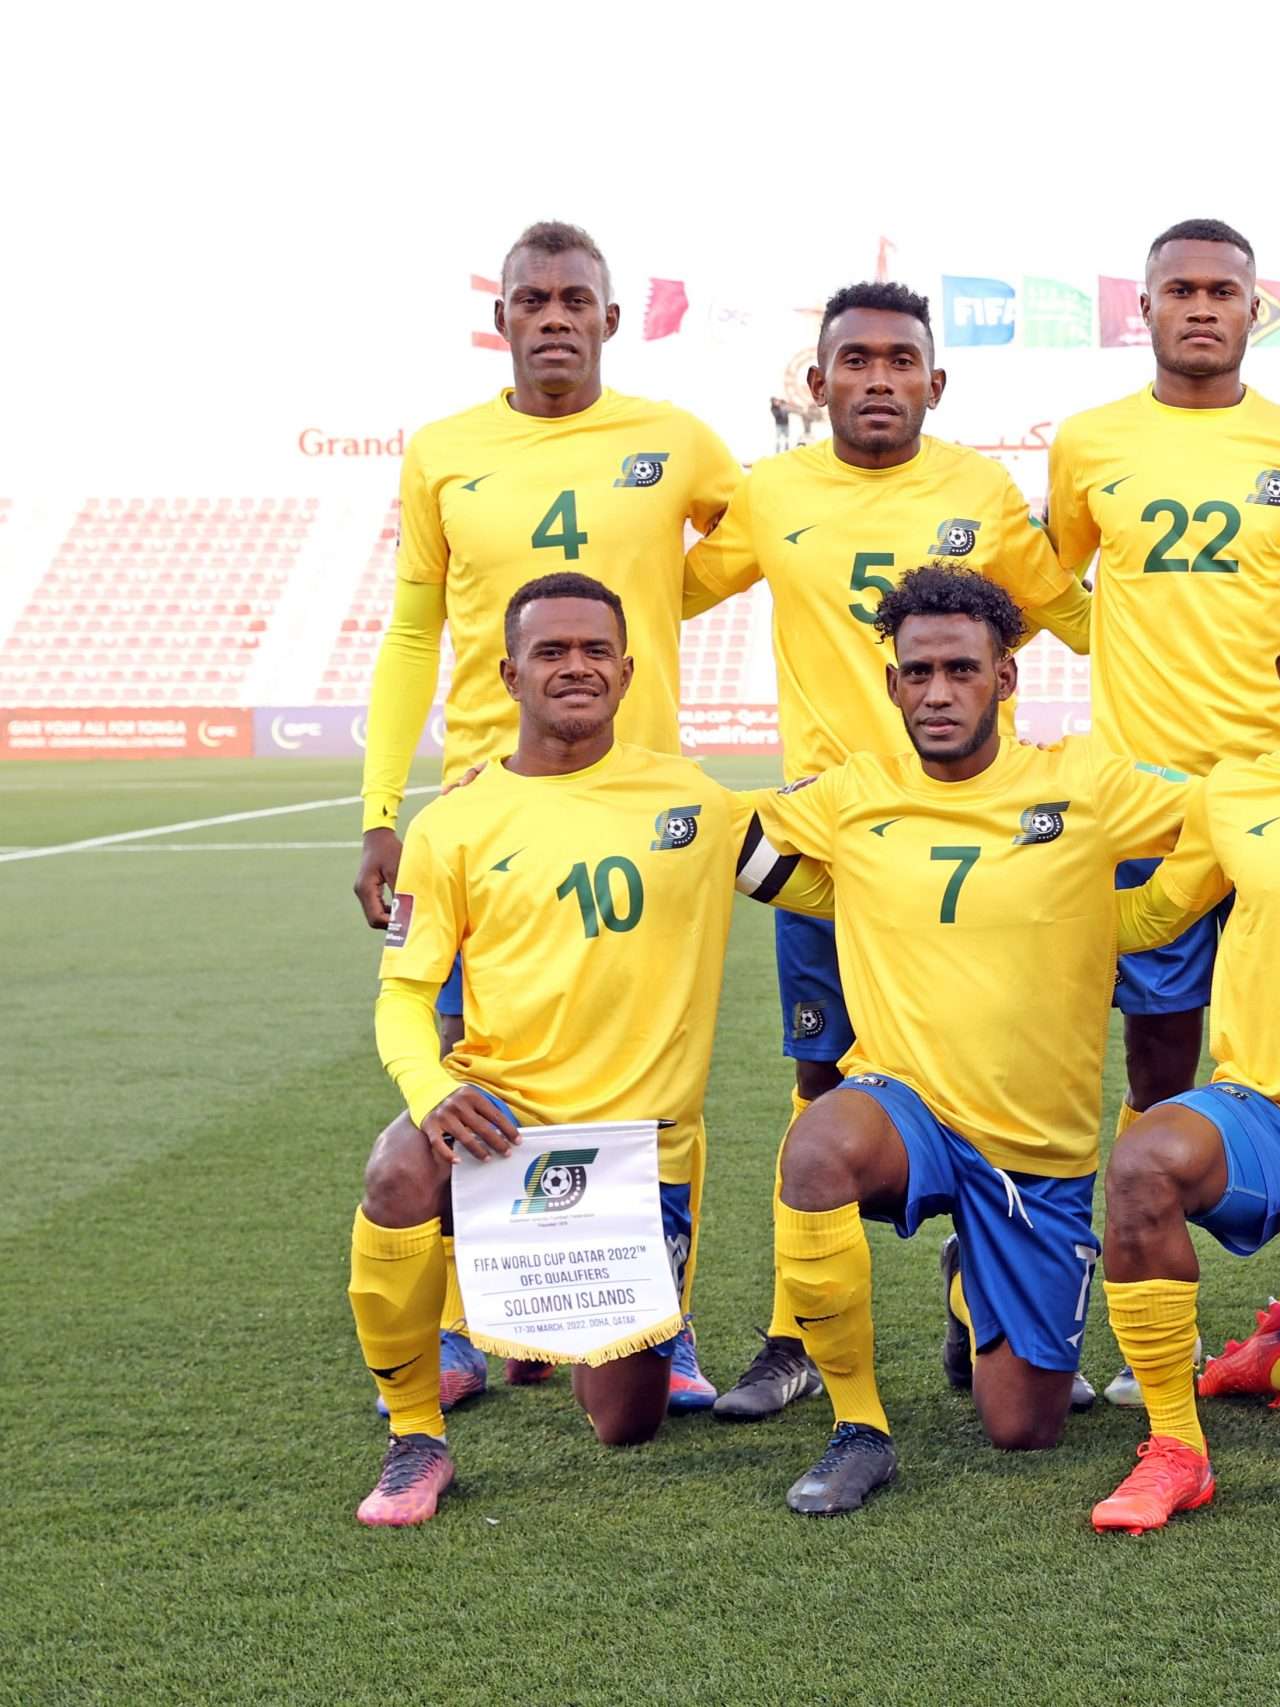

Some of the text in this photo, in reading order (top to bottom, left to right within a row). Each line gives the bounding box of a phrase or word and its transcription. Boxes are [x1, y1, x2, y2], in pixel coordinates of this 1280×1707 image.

[953, 297, 1016, 326] FIFA
[298, 428, 404, 457] Grand
[533, 491, 586, 559] 4
[1144, 499, 1240, 572] 22
[849, 552, 895, 624] 5
[559, 856, 642, 938] 10
[932, 847, 980, 923] 7
[474, 1257, 499, 1273] FIFA
[501, 1254, 541, 1271] WORLD
[543, 1251, 566, 1267] CUP
[568, 1249, 605, 1265] QATAR
[519, 1268, 610, 1286] OFC QUALIFIERS
[503, 1288, 636, 1317] SOLOMON ISLANDS
[513, 1325, 536, 1334] 17-30
[613, 1315, 636, 1326] QATAR
